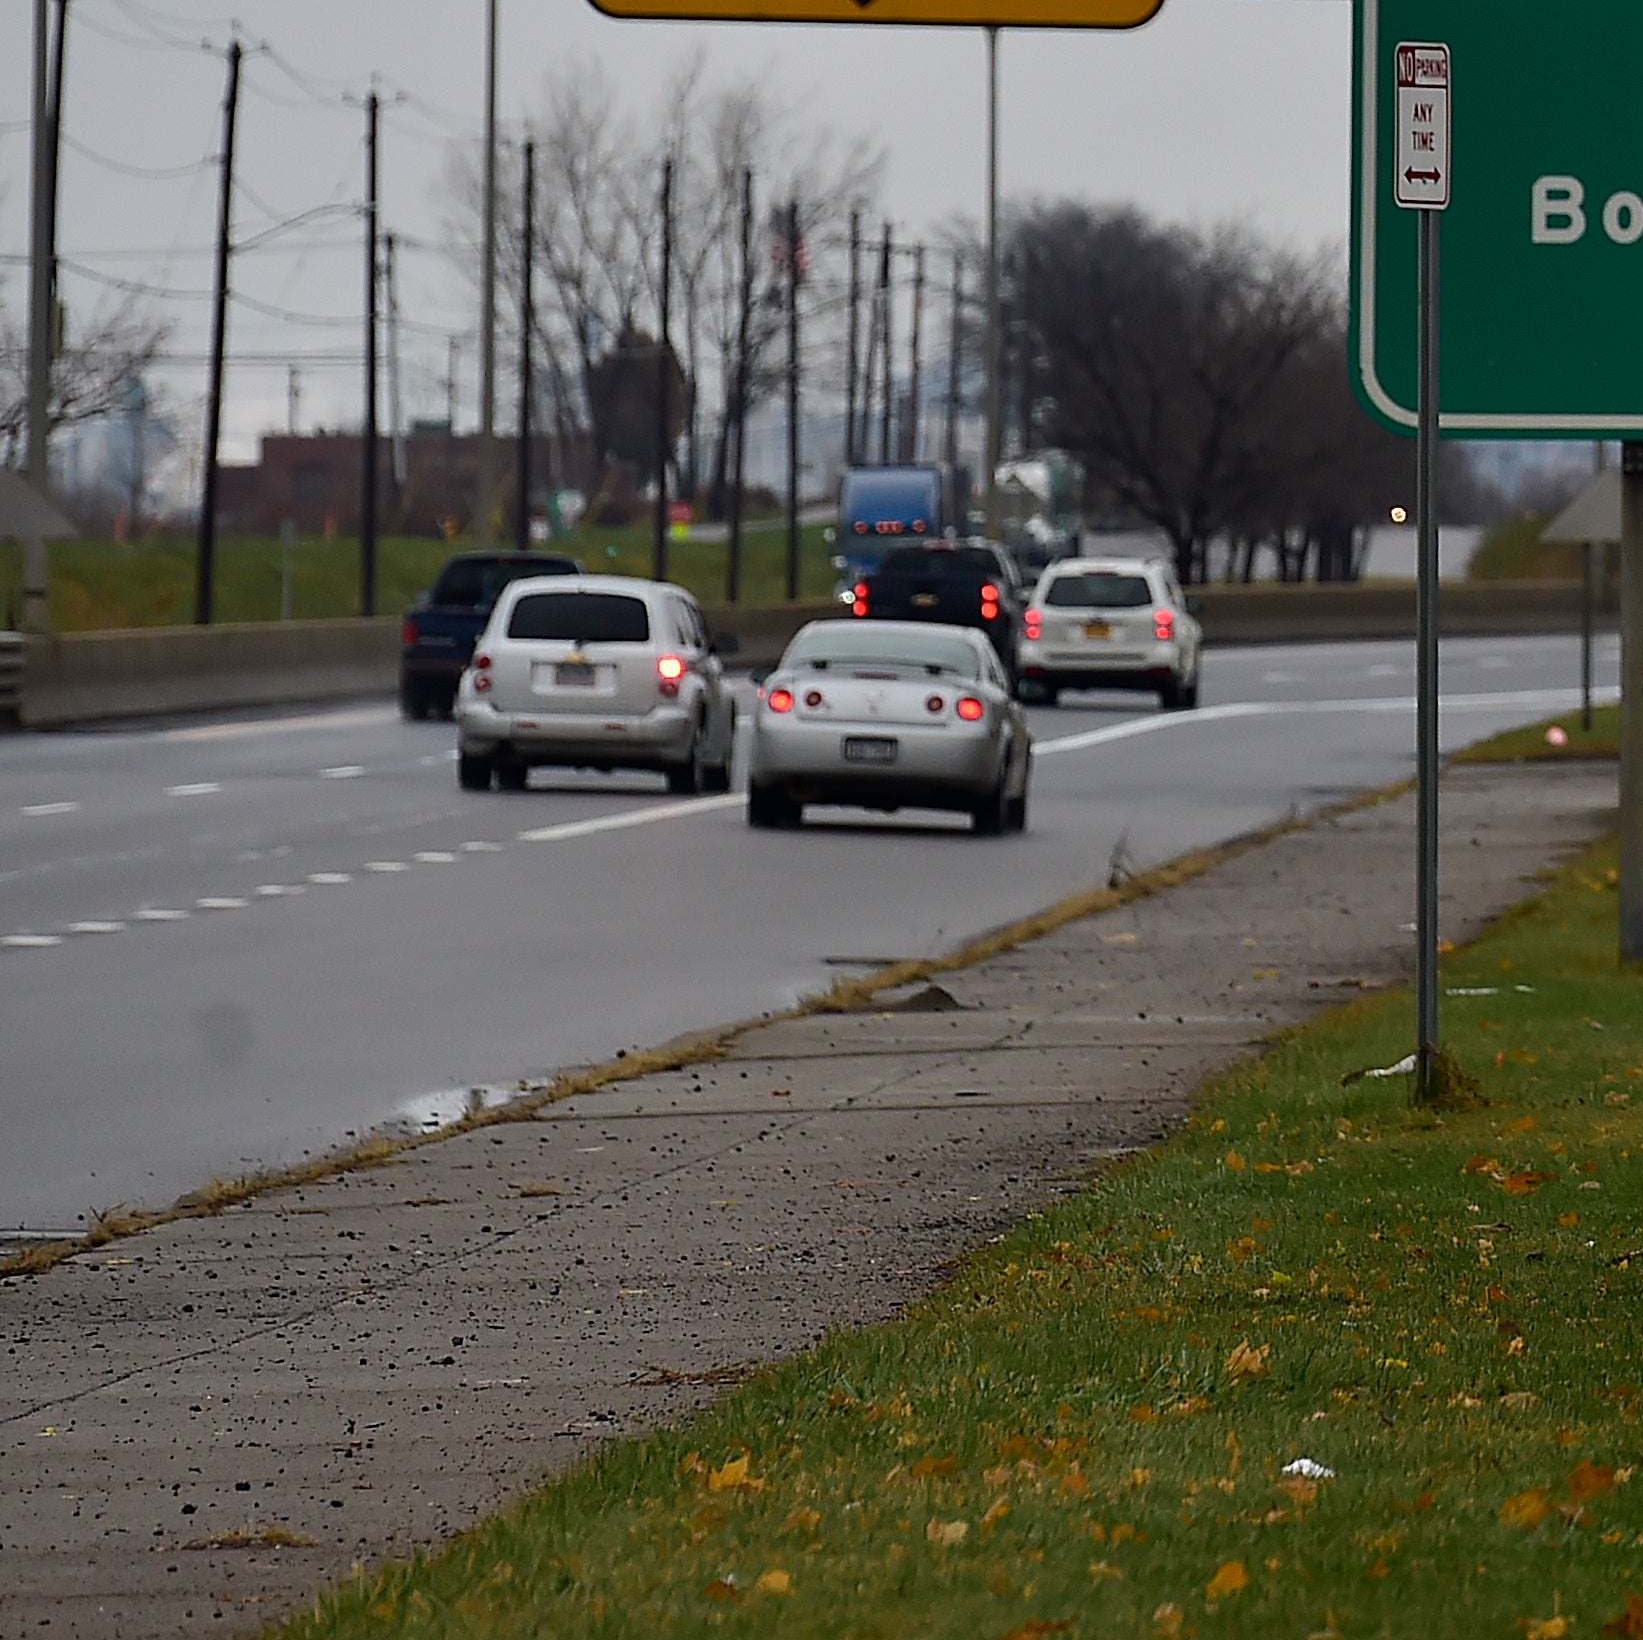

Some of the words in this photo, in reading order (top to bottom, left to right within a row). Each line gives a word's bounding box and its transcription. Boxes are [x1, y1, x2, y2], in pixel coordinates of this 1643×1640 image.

[1398, 51, 1414, 81] NO
[1412, 103, 1434, 123] ANY
[1411, 130, 1435, 151] TIME
